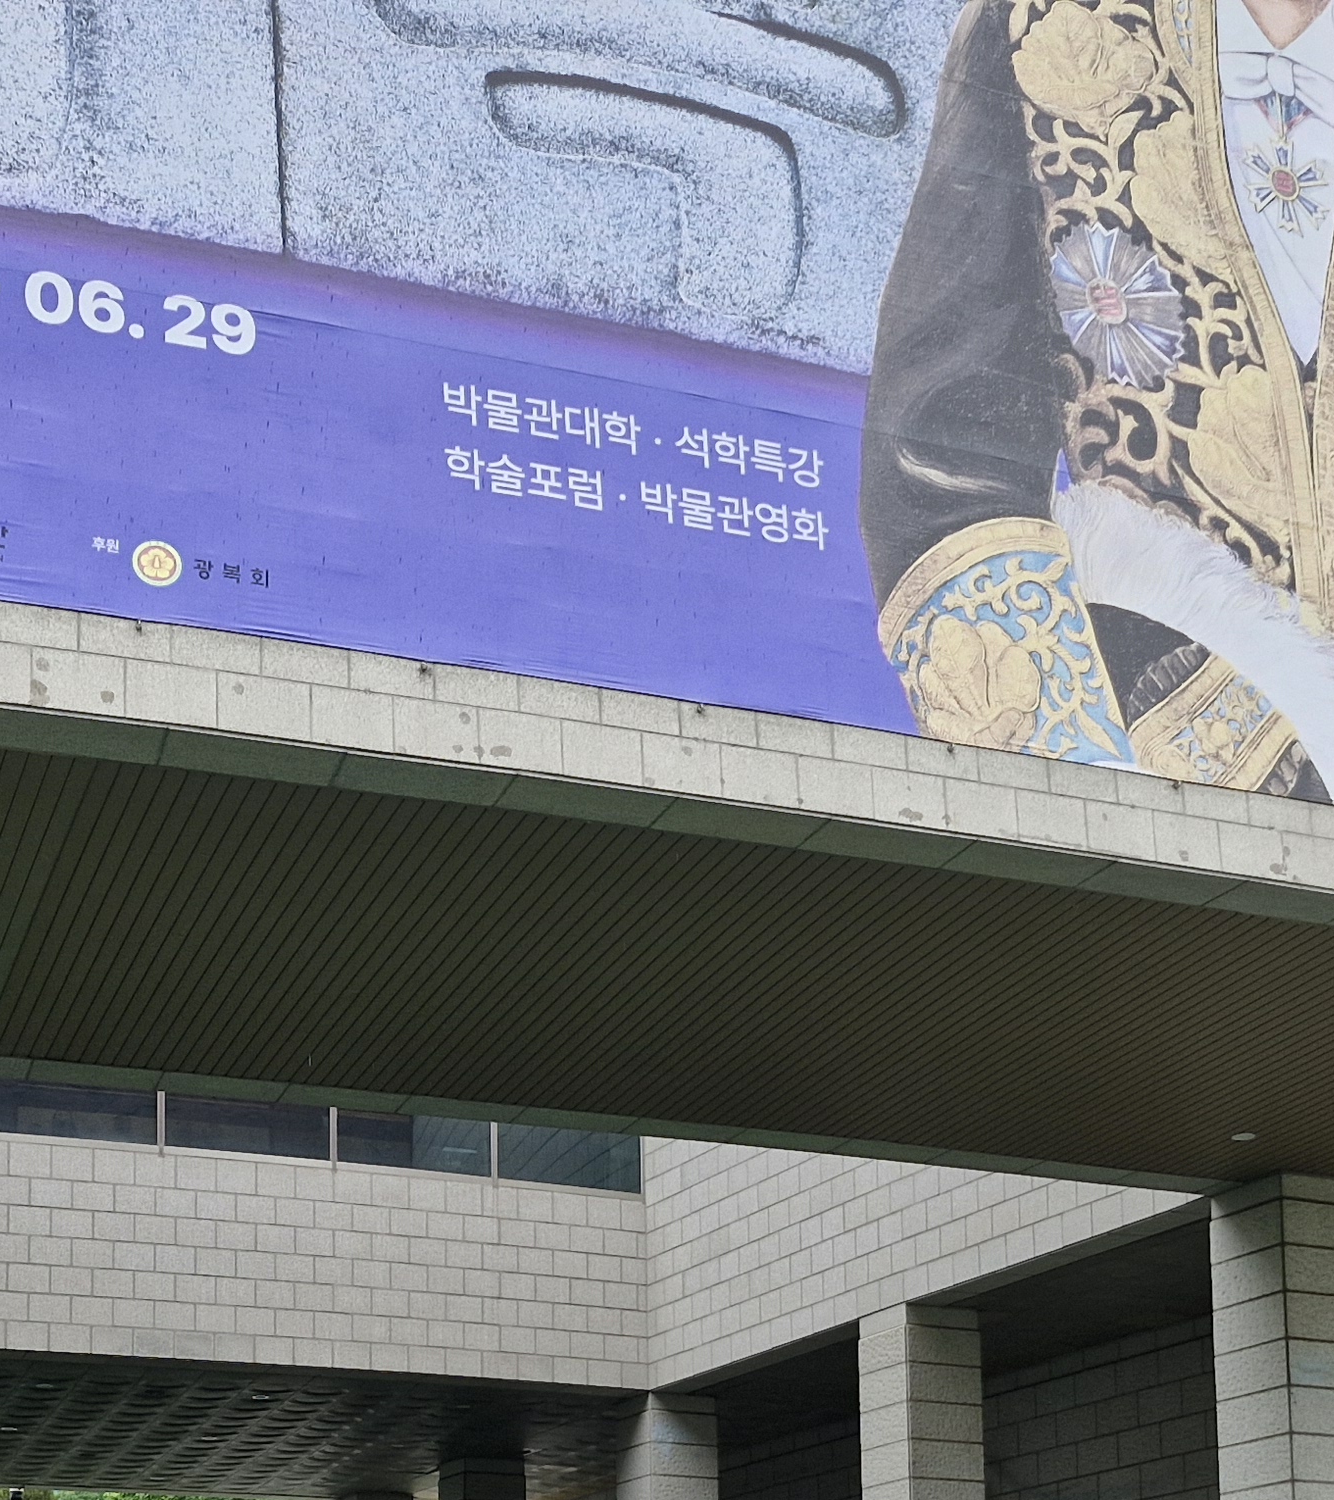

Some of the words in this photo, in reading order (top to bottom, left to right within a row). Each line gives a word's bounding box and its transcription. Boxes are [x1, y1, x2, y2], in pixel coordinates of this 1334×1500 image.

[24, 271, 145, 339] 06.
[162, 295, 257, 355] 29
[443, 382, 641, 455] 박물관대학
[674, 426, 824, 488] 석학특강
[92, 536, 120, 554] 후원
[444, 445, 603, 511] 학술포럼
[640, 480, 829, 551] 박물관영화
